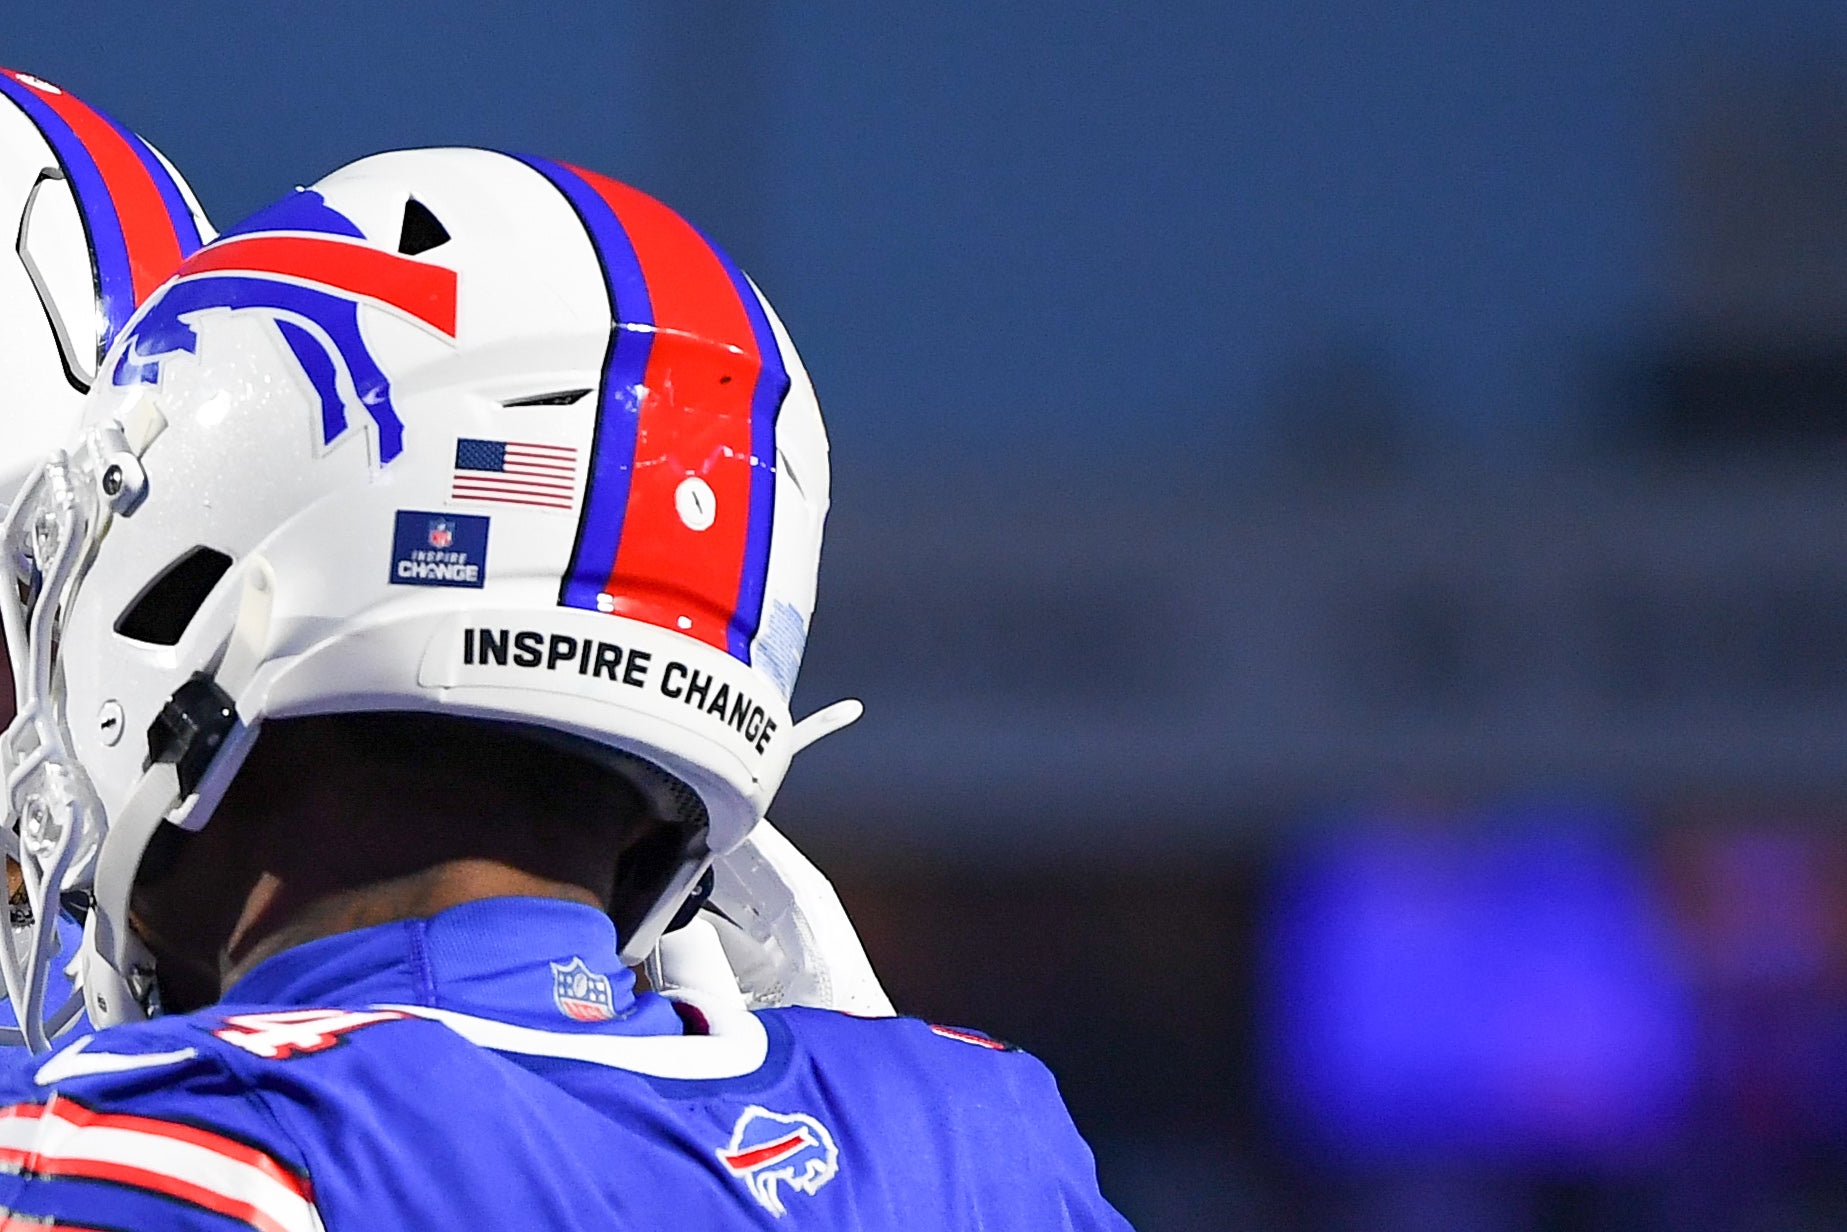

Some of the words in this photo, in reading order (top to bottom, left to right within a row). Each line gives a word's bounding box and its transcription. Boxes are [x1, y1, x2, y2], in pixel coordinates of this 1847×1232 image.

[411, 549, 468, 565] INSPIRE
[397, 560, 479, 582] CHANGE
[463, 627, 652, 688] INSPIRE
[660, 661, 777, 755] CHANGE
